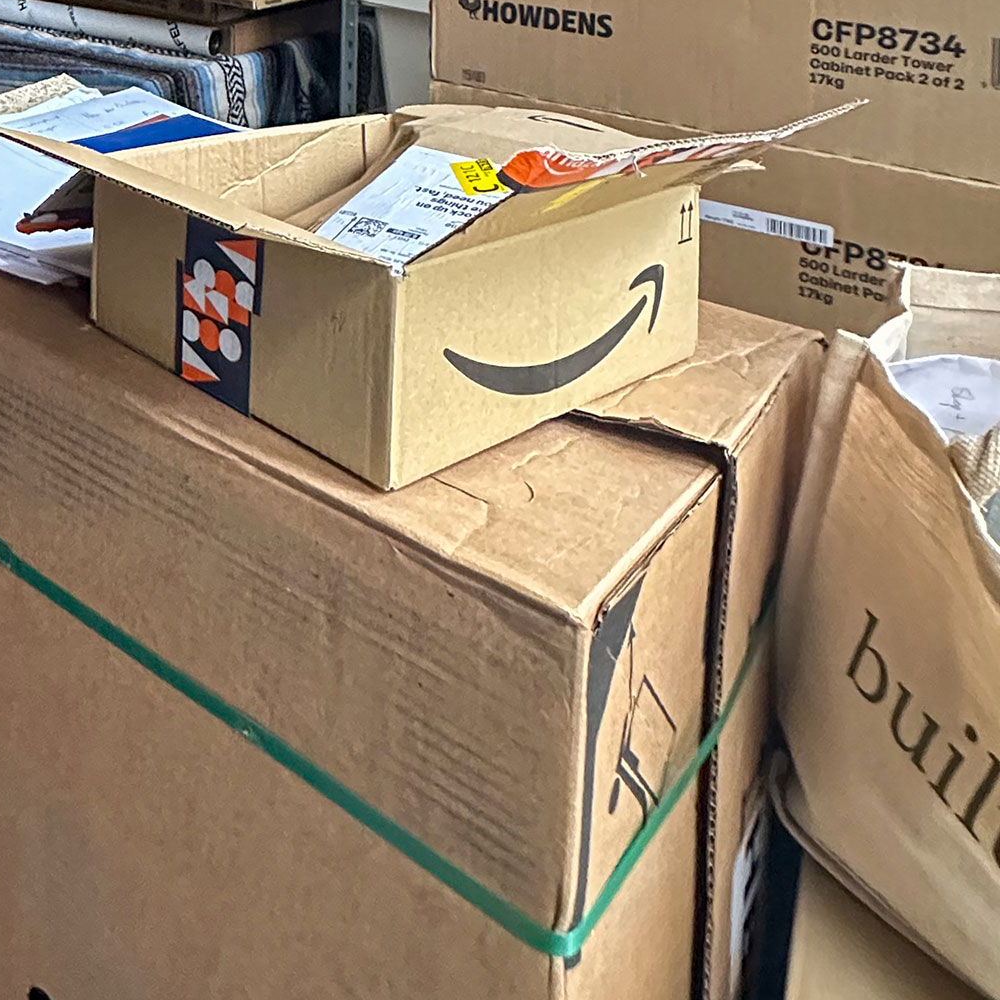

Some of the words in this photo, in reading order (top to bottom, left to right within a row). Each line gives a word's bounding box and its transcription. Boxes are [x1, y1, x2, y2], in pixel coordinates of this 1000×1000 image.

[482, 0, 614, 38] HOWDENS
[812, 18, 966, 58] CFP8734
[810, 43, 841, 57] 500
[844, 47, 898, 65] Larder
[902, 55, 955, 73] Tower
[809, 58, 871, 77] Cabinet
[874, 66, 915, 84] Pack
[918, 74, 929, 85] 2
[932, 76, 950, 88] of
[954, 78, 965, 91] 2
[809, 72, 845, 90] 17kg
[415, 201, 432, 209] on
[430, 197, 469, 210] things
[432, 204, 449, 212] up
[798, 272, 860, 297] Cabinet
[800, 257, 830, 273] 500
[833, 262, 887, 287] Larder
[798, 286, 834, 306] 17kg
[847, 607, 1000, 870] buil
